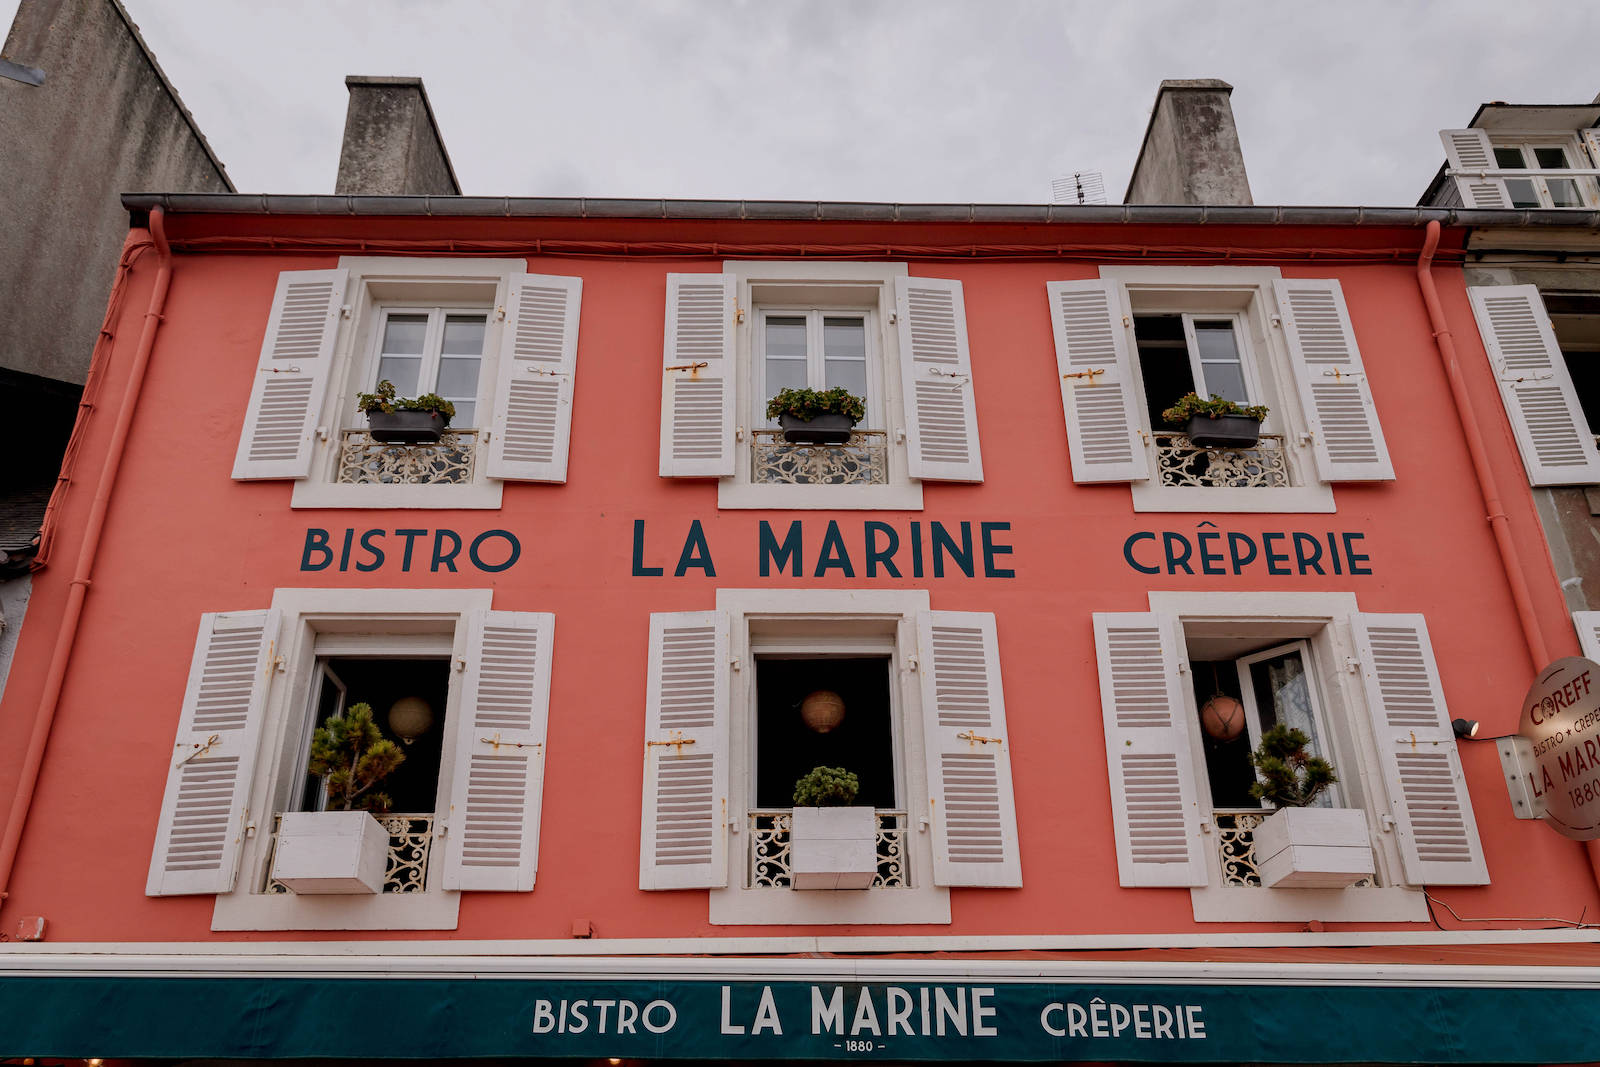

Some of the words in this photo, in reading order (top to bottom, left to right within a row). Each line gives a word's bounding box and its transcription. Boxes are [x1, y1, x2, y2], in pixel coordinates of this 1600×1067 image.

[300, 528, 521, 573] BISTRO
[632, 519, 717, 578] LA
[759, 519, 1016, 579] MARINE
[1124, 520, 1373, 576] CRÊPERIE
[1530, 669, 1591, 726] COREFF
[1533, 731, 1564, 758] BISTRO
[1573, 706, 1600, 733] CREPE
[1529, 764, 1555, 798] LA
[1568, 778, 1600, 809] 1880
[533, 999, 677, 1034] BISTRO
[721, 986, 783, 1036] LA
[812, 986, 998, 1036] MARINE
[1041, 997, 1207, 1039] CRÊPERIE
[845, 1040, 873, 1052] 1880
